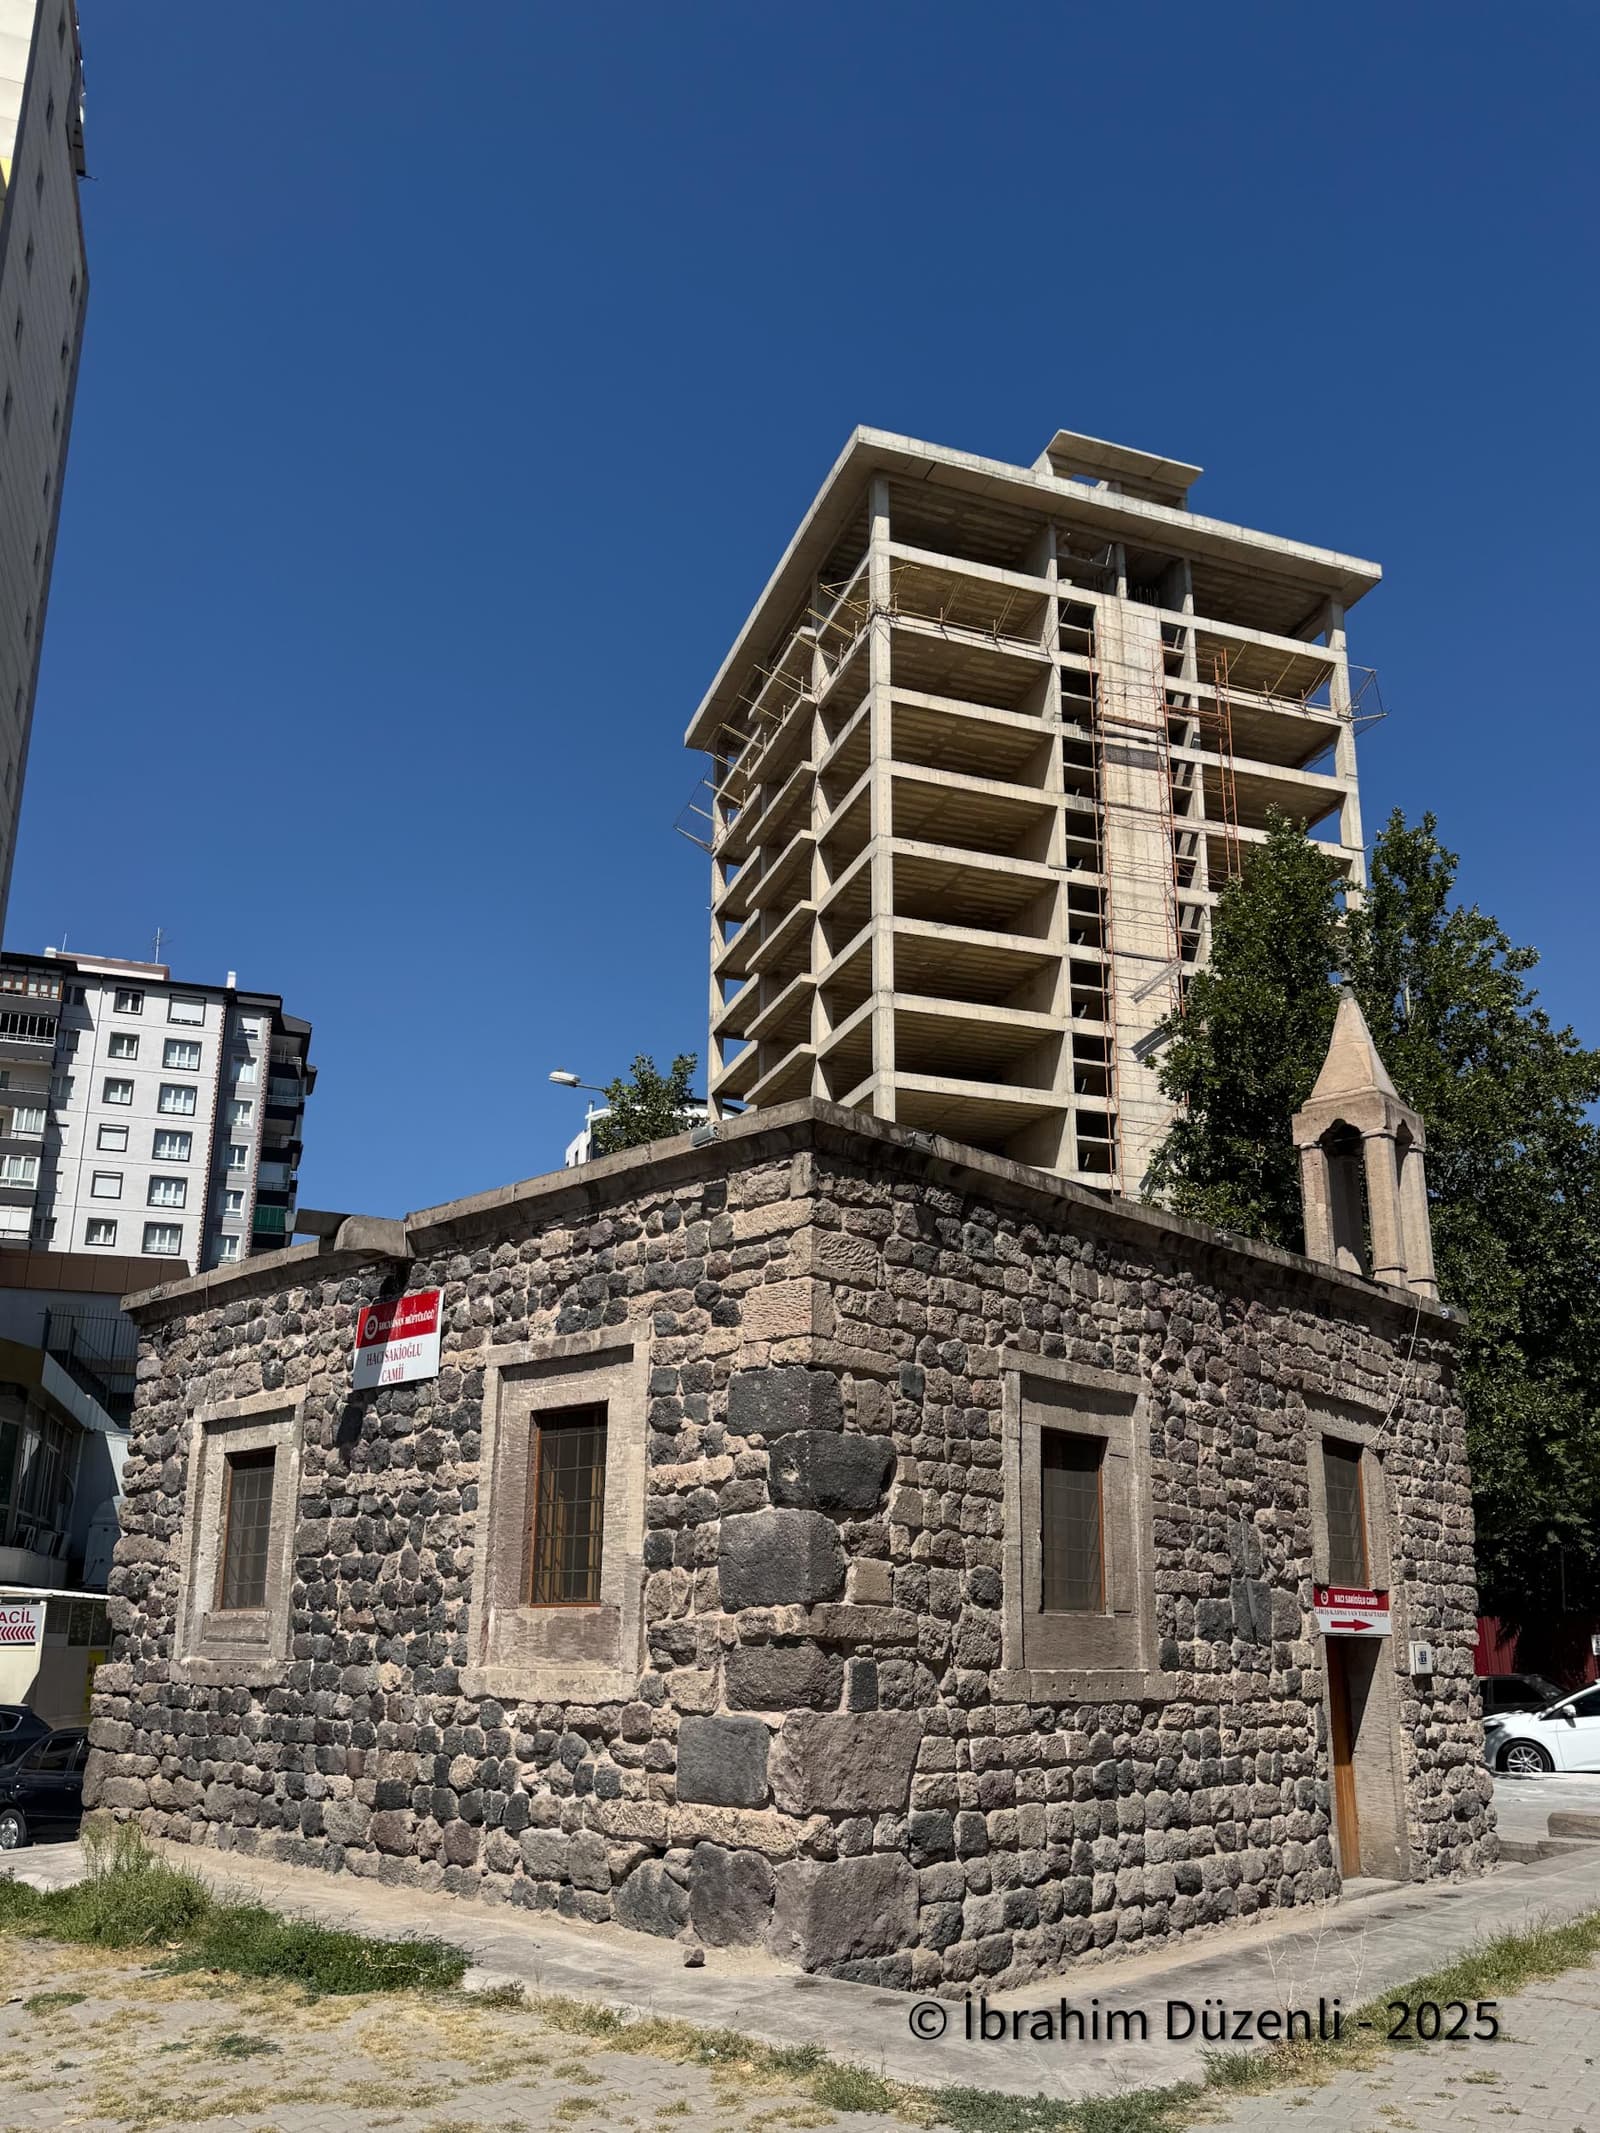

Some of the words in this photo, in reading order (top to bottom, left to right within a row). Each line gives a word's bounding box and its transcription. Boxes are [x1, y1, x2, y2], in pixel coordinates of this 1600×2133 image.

[366, 1350, 384, 1366] HACI
[384, 1342, 422, 1363] SAKİOĞLU
[381, 1363, 404, 1382] CAMİİ
[0, 1608, 34, 1624] ACİL
